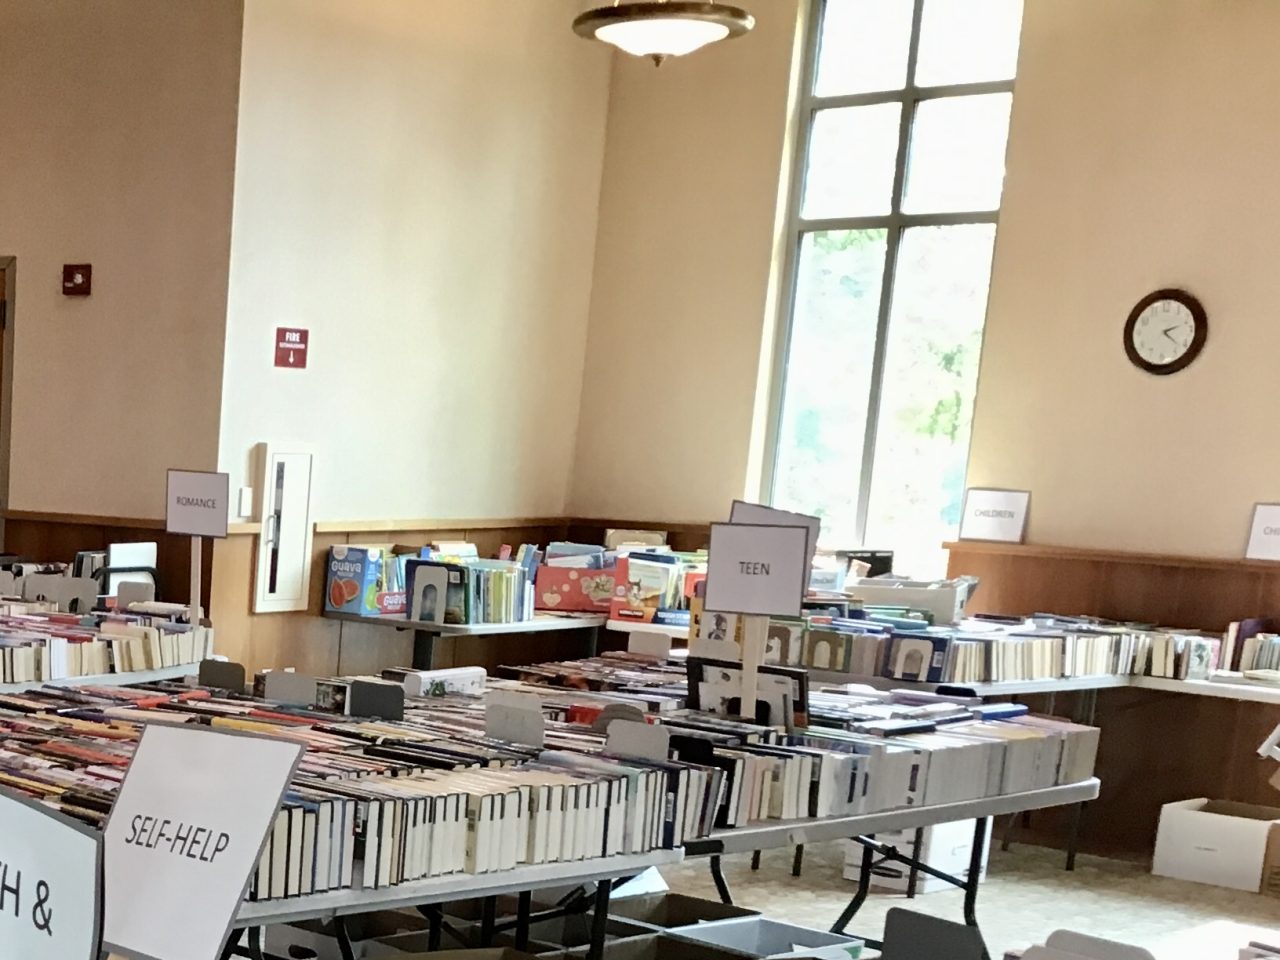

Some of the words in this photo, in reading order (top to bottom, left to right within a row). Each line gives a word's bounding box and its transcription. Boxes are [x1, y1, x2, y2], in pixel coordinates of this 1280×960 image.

[285, 332, 300, 342] FIRE
[176, 495, 217, 509] ROMANCE
[974, 508, 1016, 520] CHILDREN
[739, 560, 770, 576] TEEN
[125, 814, 230, 863] SELF-HELP
[32, 879, 53, 936] &
